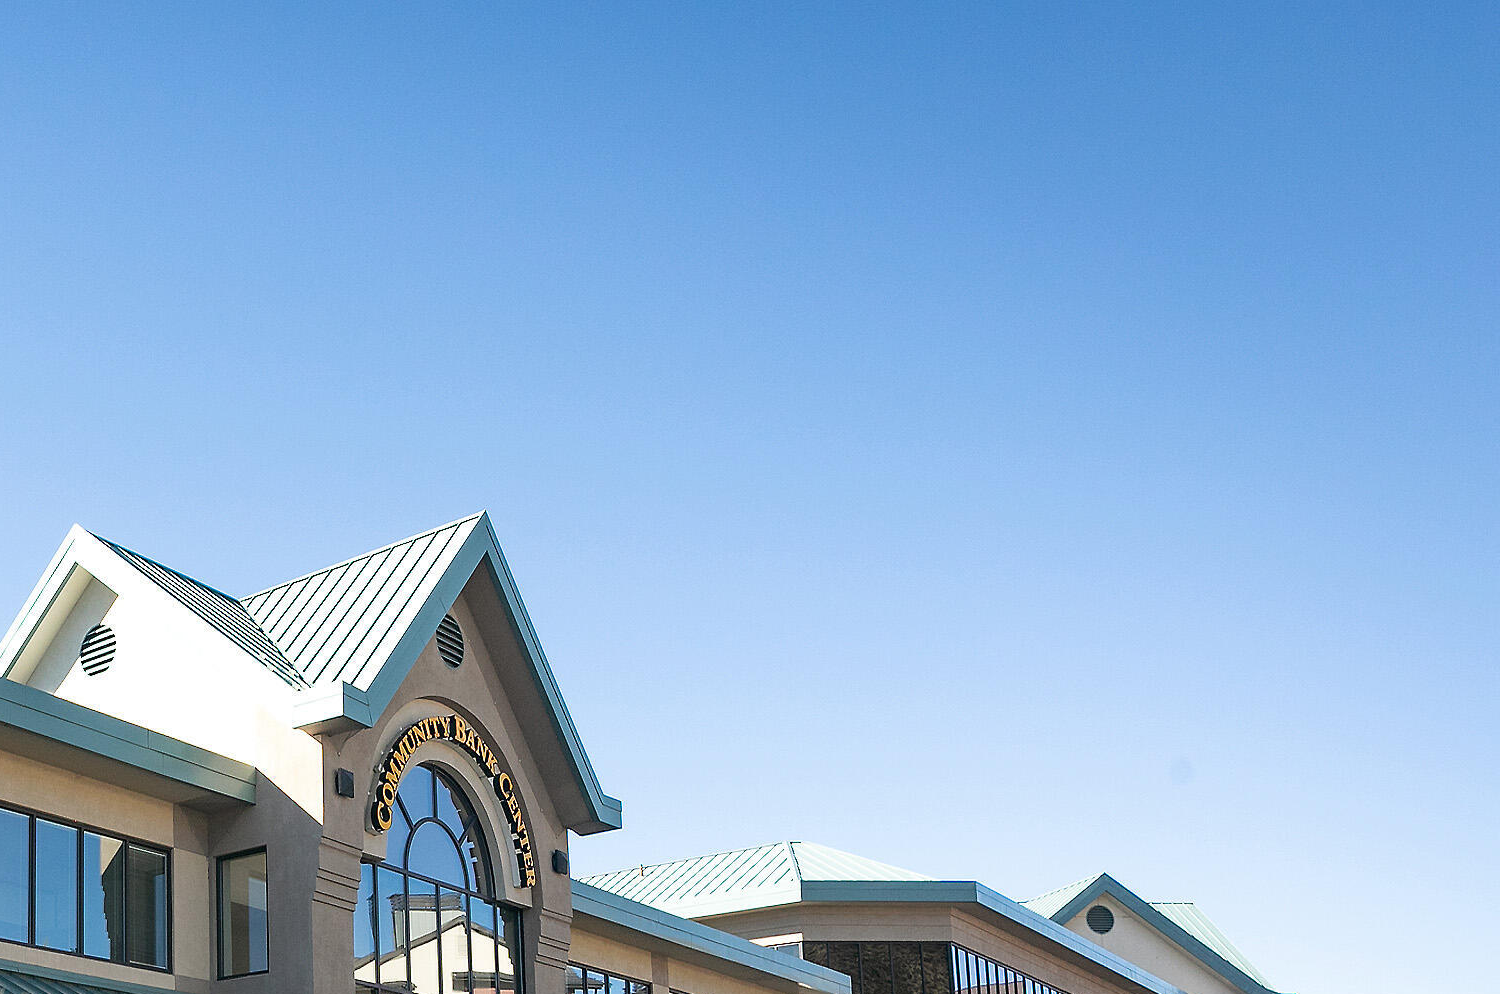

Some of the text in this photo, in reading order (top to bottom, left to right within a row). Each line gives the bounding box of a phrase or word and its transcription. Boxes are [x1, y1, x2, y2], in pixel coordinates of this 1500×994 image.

[372, 713, 536, 888] COMMUNITY BANK CENTER
